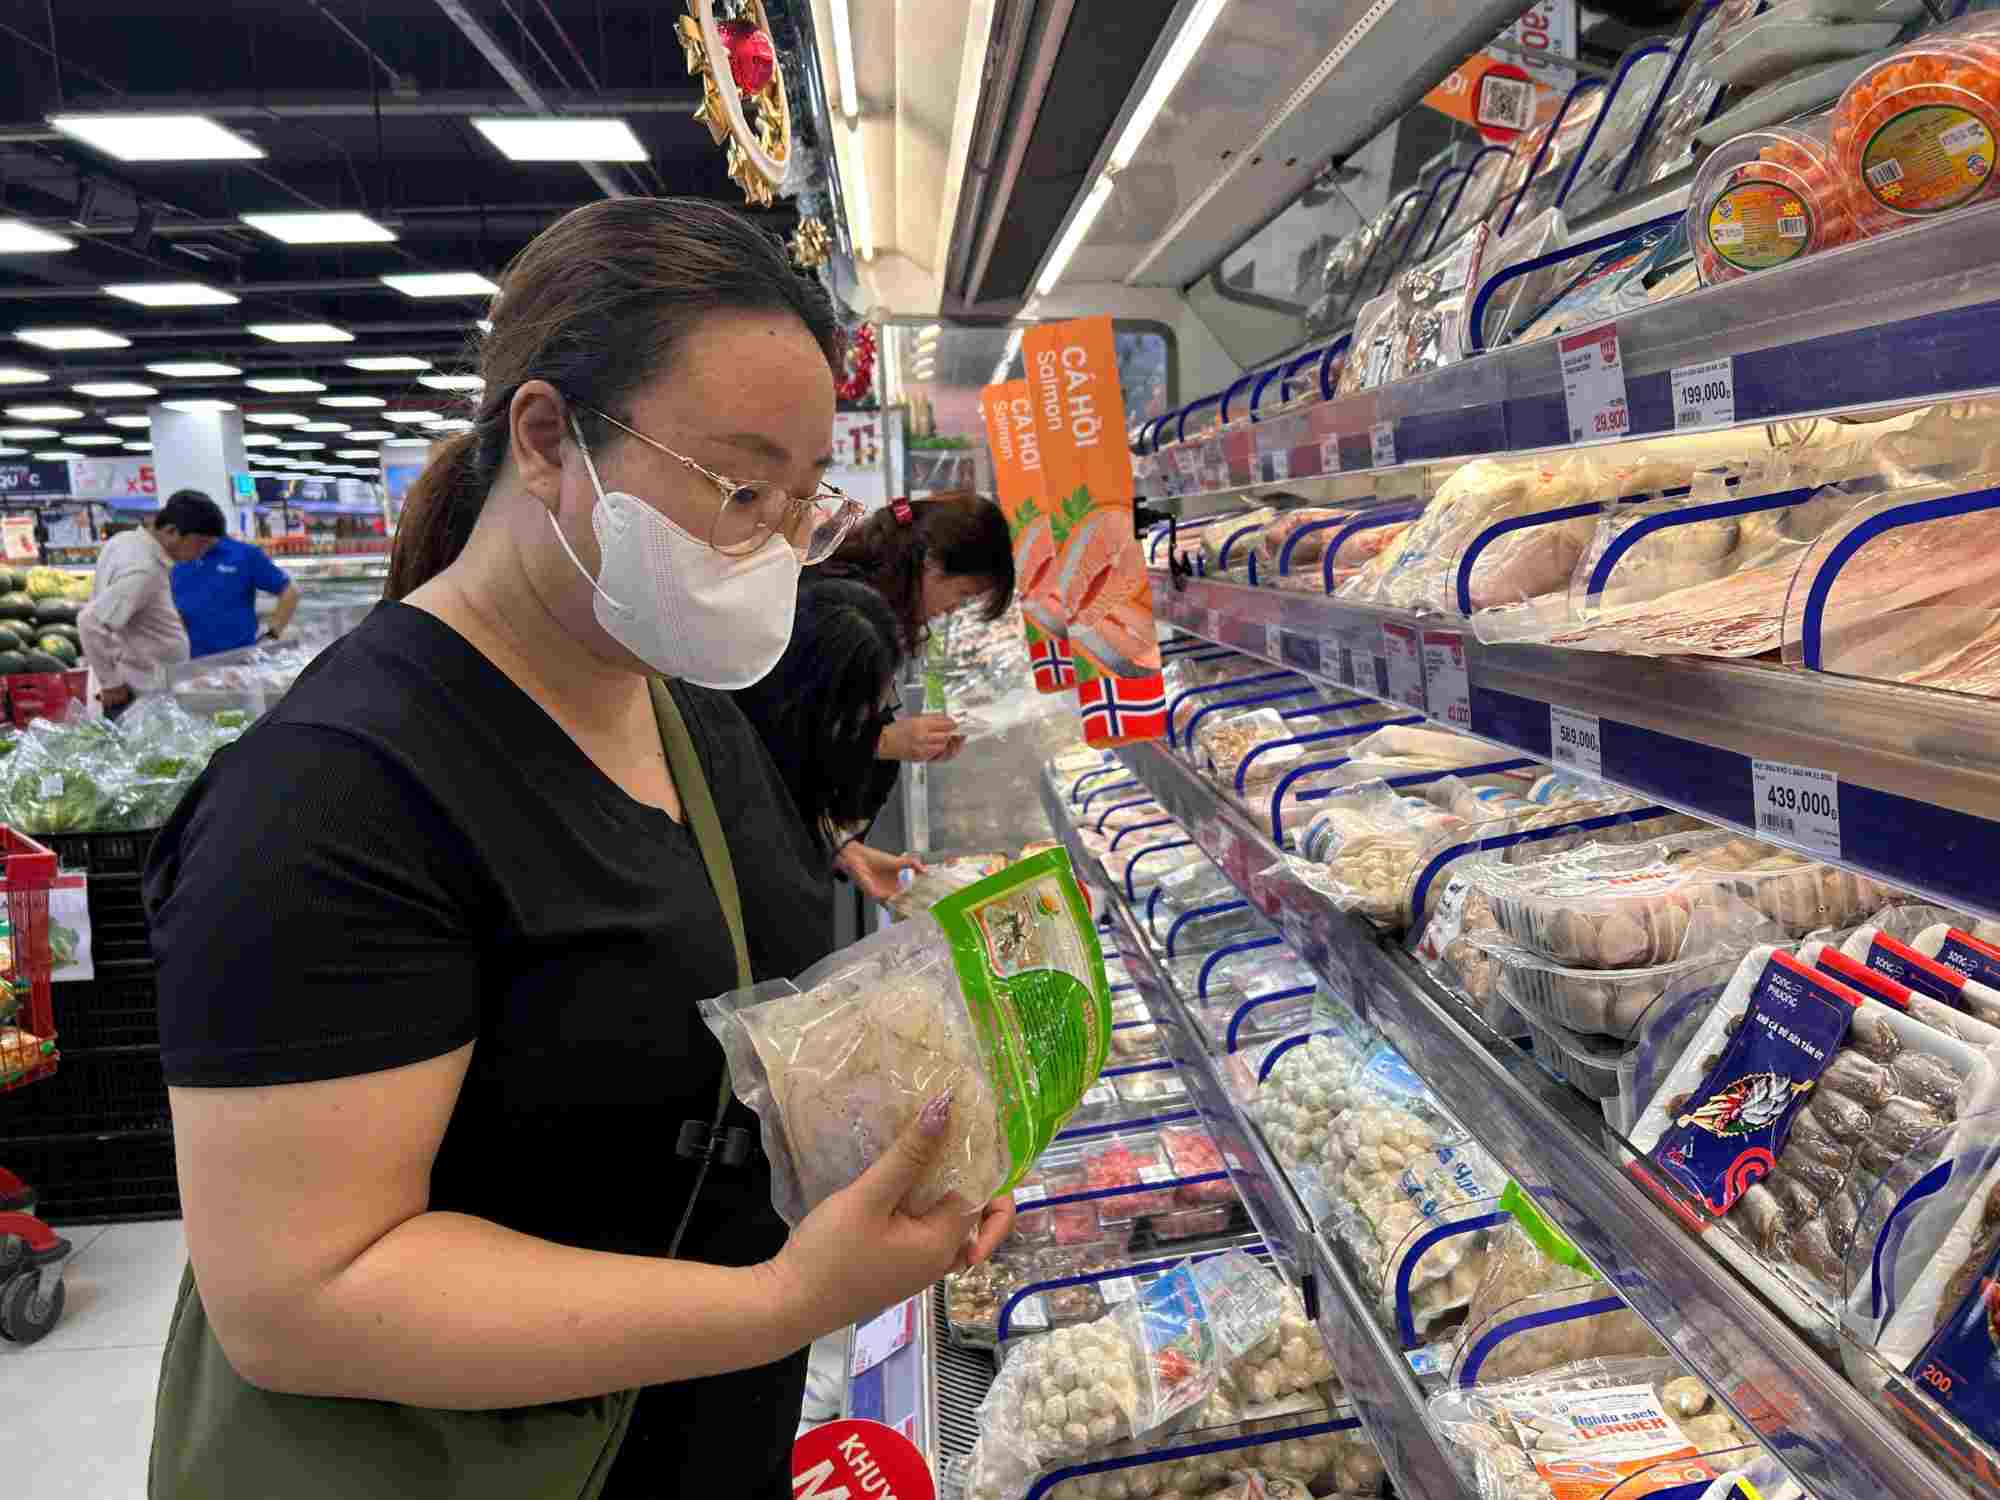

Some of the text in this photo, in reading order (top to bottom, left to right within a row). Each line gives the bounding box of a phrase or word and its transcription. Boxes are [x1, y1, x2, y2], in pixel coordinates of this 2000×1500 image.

[1036, 350, 1065, 432] Salmon
[1767, 785, 1830, 817] 439,000
[1920, 1364, 1952, 1392] 200
